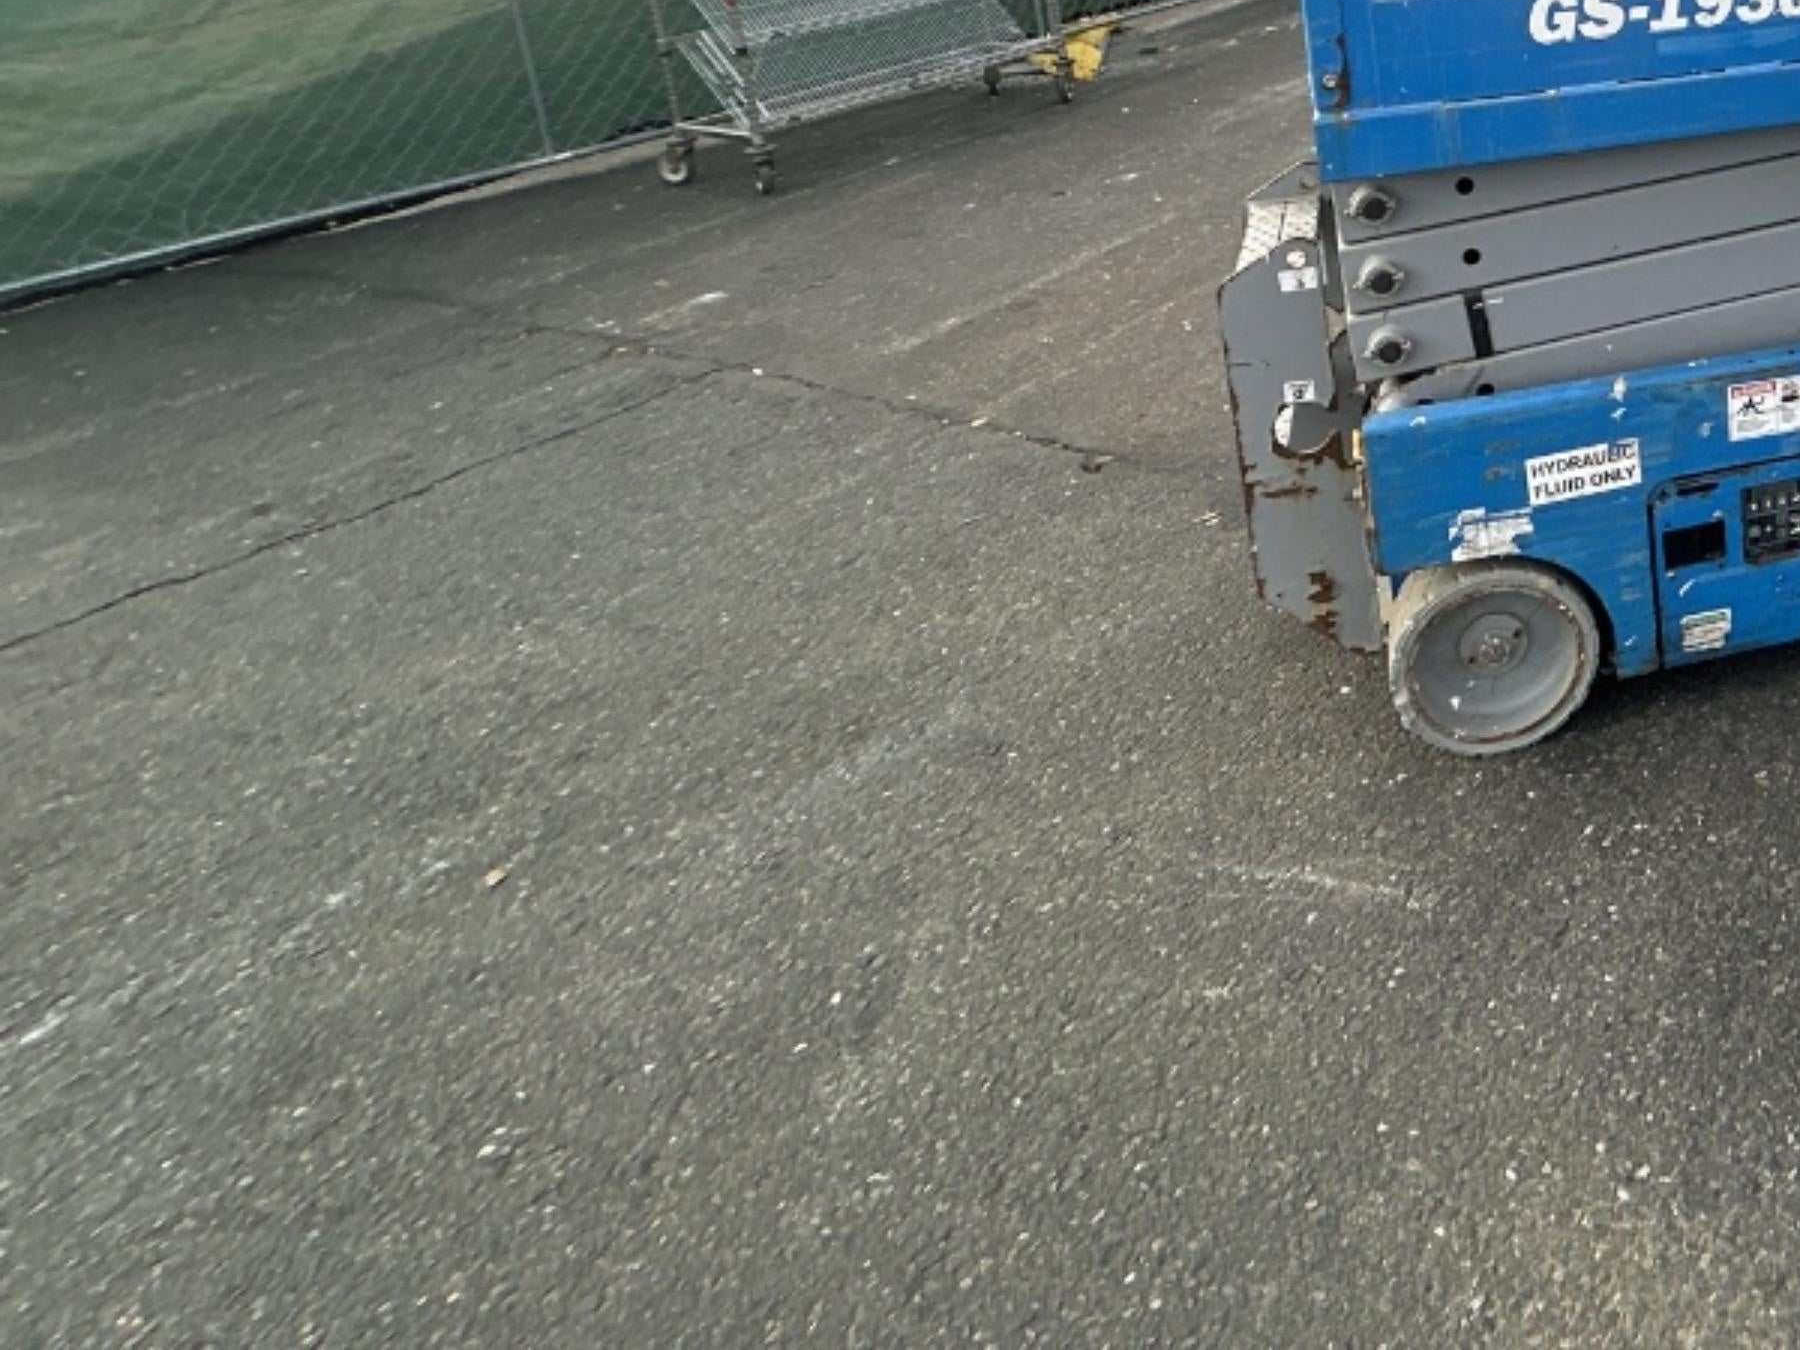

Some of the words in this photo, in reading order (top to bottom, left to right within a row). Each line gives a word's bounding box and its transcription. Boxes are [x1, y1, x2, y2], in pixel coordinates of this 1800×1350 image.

[1530, 441, 1637, 479] HYDRAULIC
[1533, 476, 1585, 499] FLUID
[1589, 464, 1636, 487] ONLY
